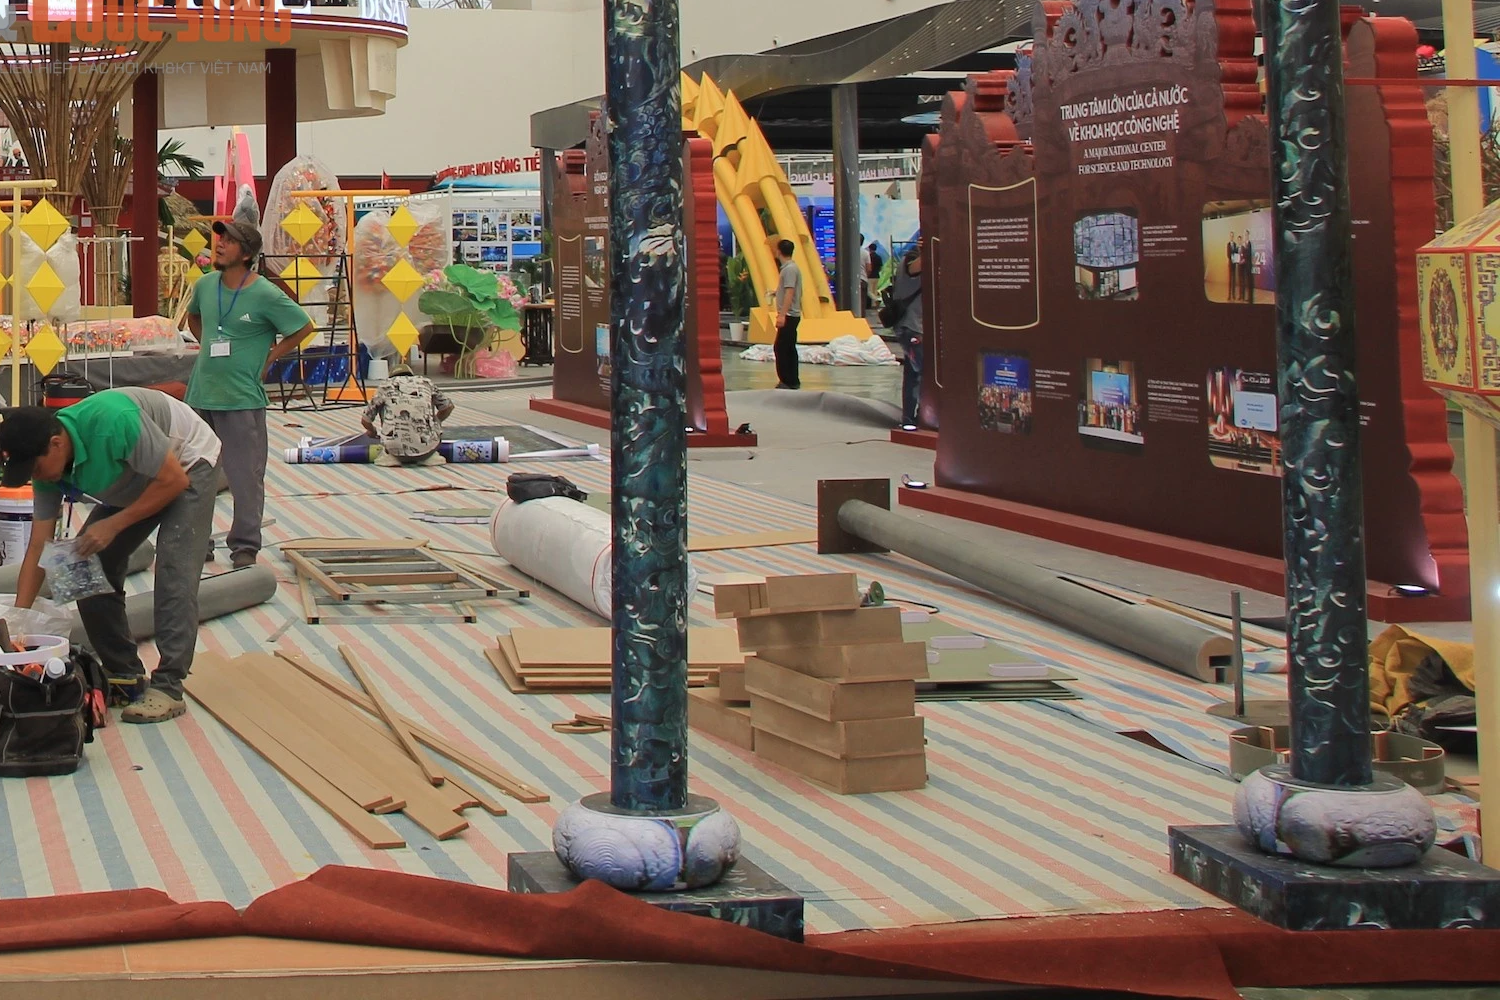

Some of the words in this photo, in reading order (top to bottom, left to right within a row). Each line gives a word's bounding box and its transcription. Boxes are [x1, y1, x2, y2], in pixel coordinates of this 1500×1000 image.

[1060, 102, 1088, 120] TRUNG
[1088, 97, 1107, 116] TÂM
[1108, 94, 1125, 114] LỚN
[1126, 90, 1144, 110] CỦA
[1145, 87, 1158, 107] CẢ
[1159, 84, 1188, 106] NƯỚC
[1069, 121, 1080, 141] VỀ
[1081, 123, 1102, 140] KHOA
[1105, 120, 1123, 140] HỌC
[1125, 115, 1151, 134] CÔNG
[1152, 109, 1179, 133] NGHỆ
[1088, 146, 1109, 160] MAJOR
[1109, 143, 1139, 156] NATIONAL
[1140, 141, 1166, 153] CENTER
[494, 157, 520, 174] SÔNG
[523, 151, 540, 171] TIẾ
[1078, 164, 1090, 174] FOR
[1091, 162, 1116, 174] SCIENCE
[1117, 160, 1129, 172] AND
[1130, 156, 1173, 170] TECHNOLOGY
